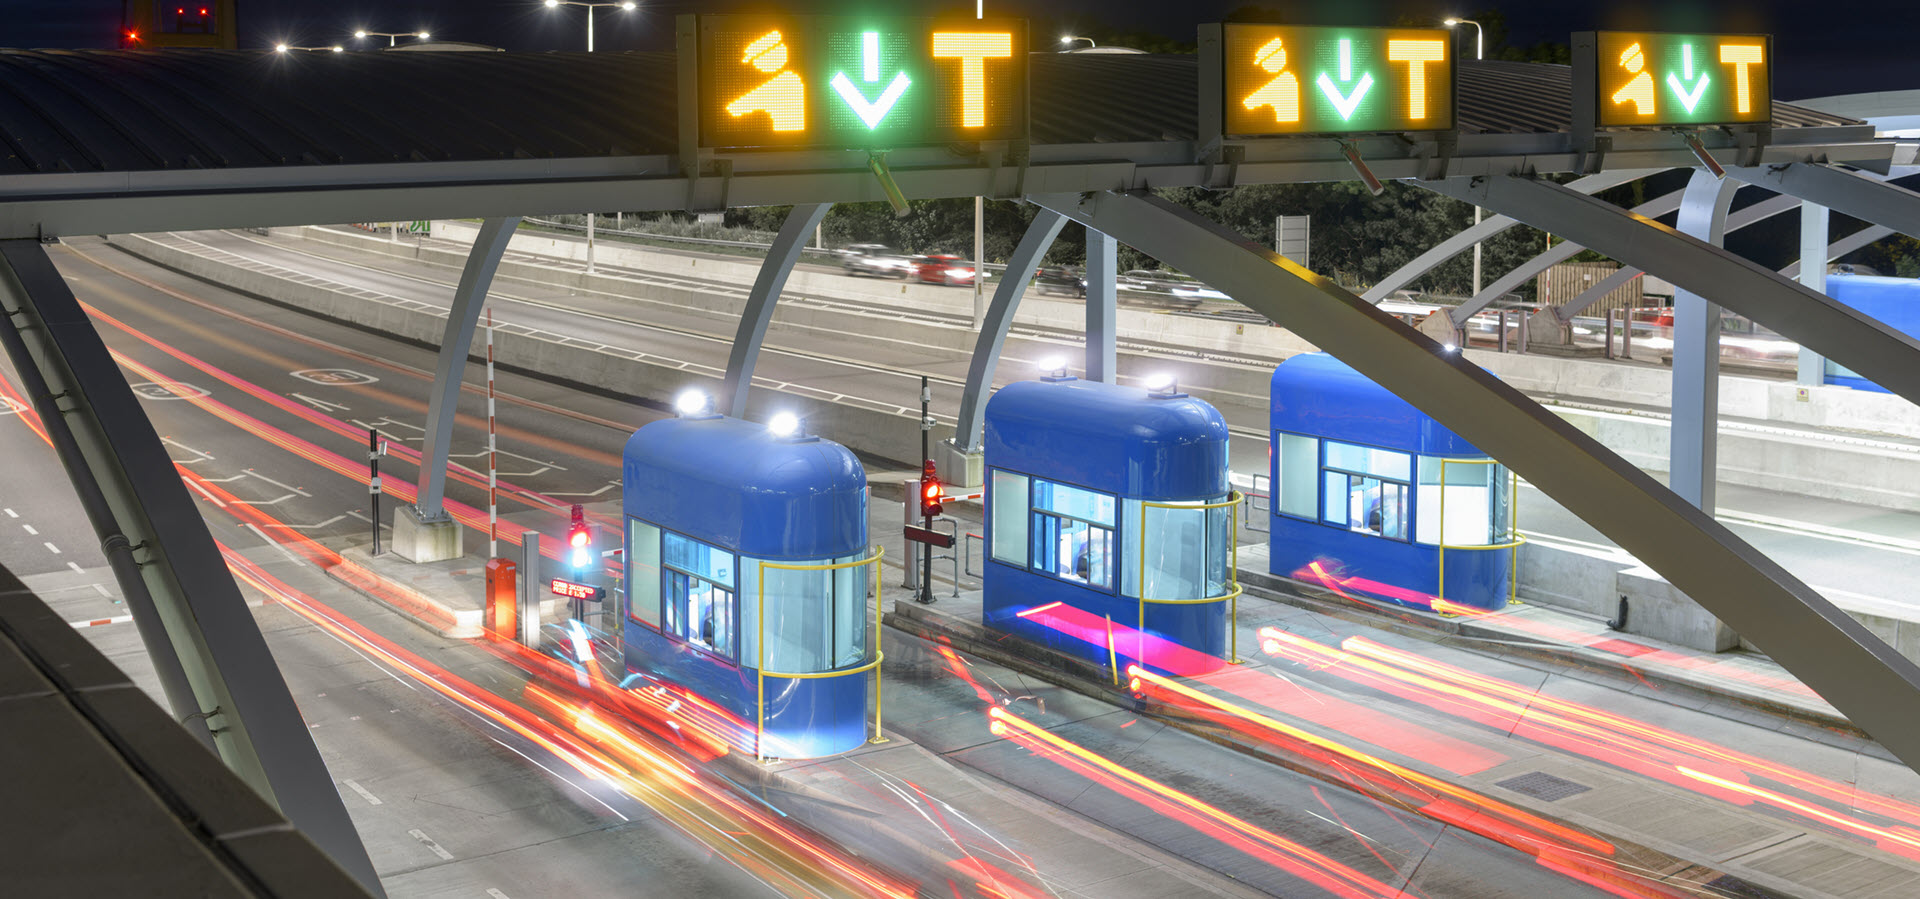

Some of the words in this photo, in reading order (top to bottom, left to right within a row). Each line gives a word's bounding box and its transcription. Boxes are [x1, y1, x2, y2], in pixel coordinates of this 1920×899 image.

[931, 30, 1013, 129] T
[1387, 38, 1445, 121] T
[1719, 43, 1763, 114] T
